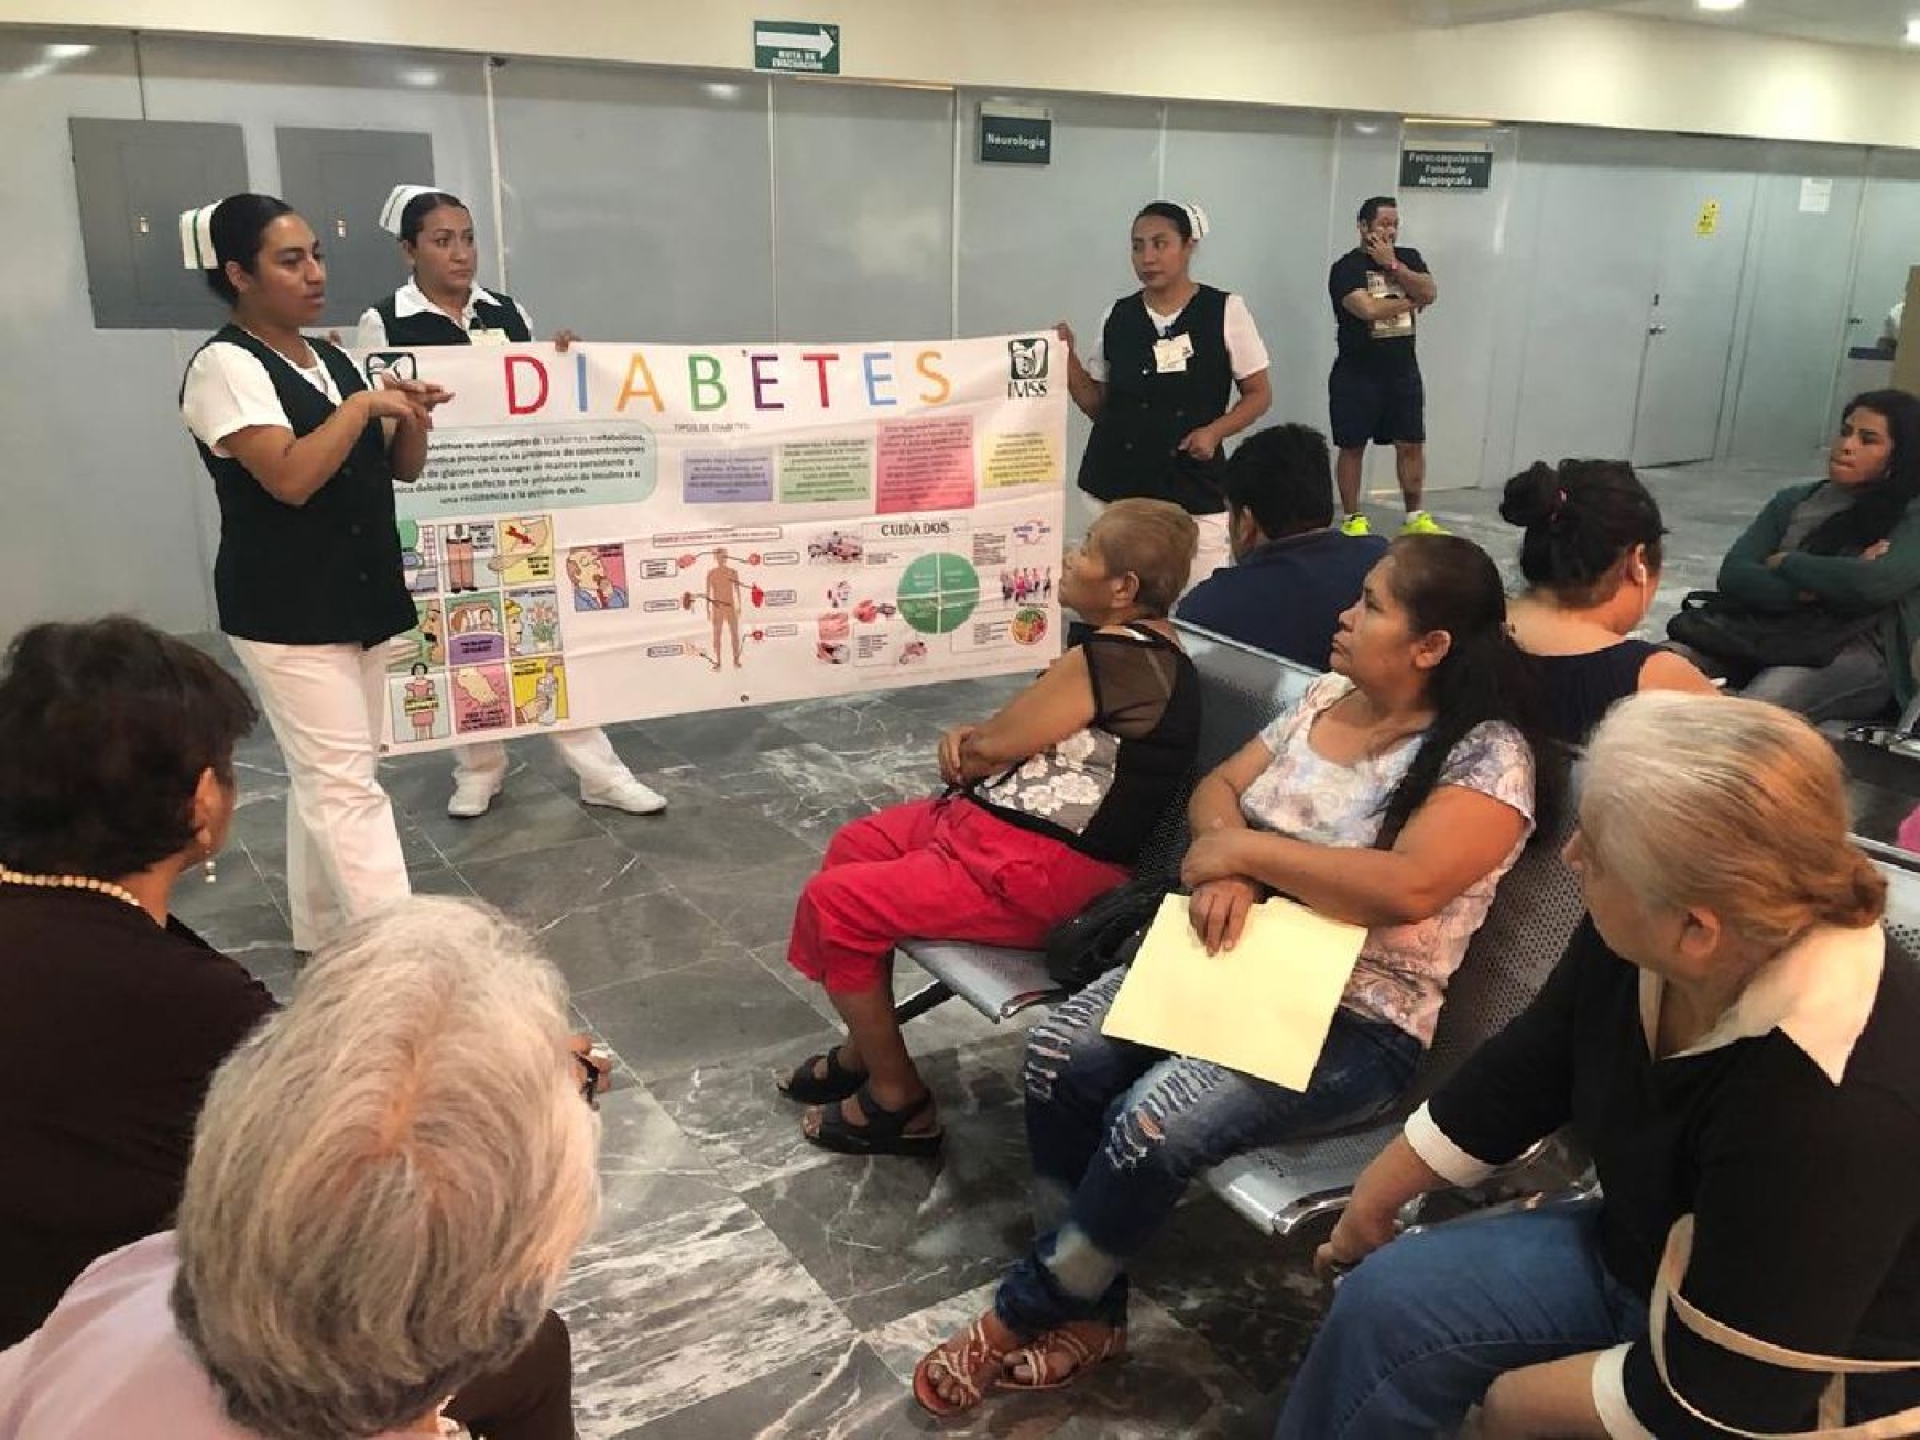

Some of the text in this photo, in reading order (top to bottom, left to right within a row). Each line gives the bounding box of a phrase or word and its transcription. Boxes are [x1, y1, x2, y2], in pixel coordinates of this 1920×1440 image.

[503, 350, 951, 415] DIABETES
[1008, 381, 1047, 398] IMSS
[881, 521, 950, 537] CUIDADOS
